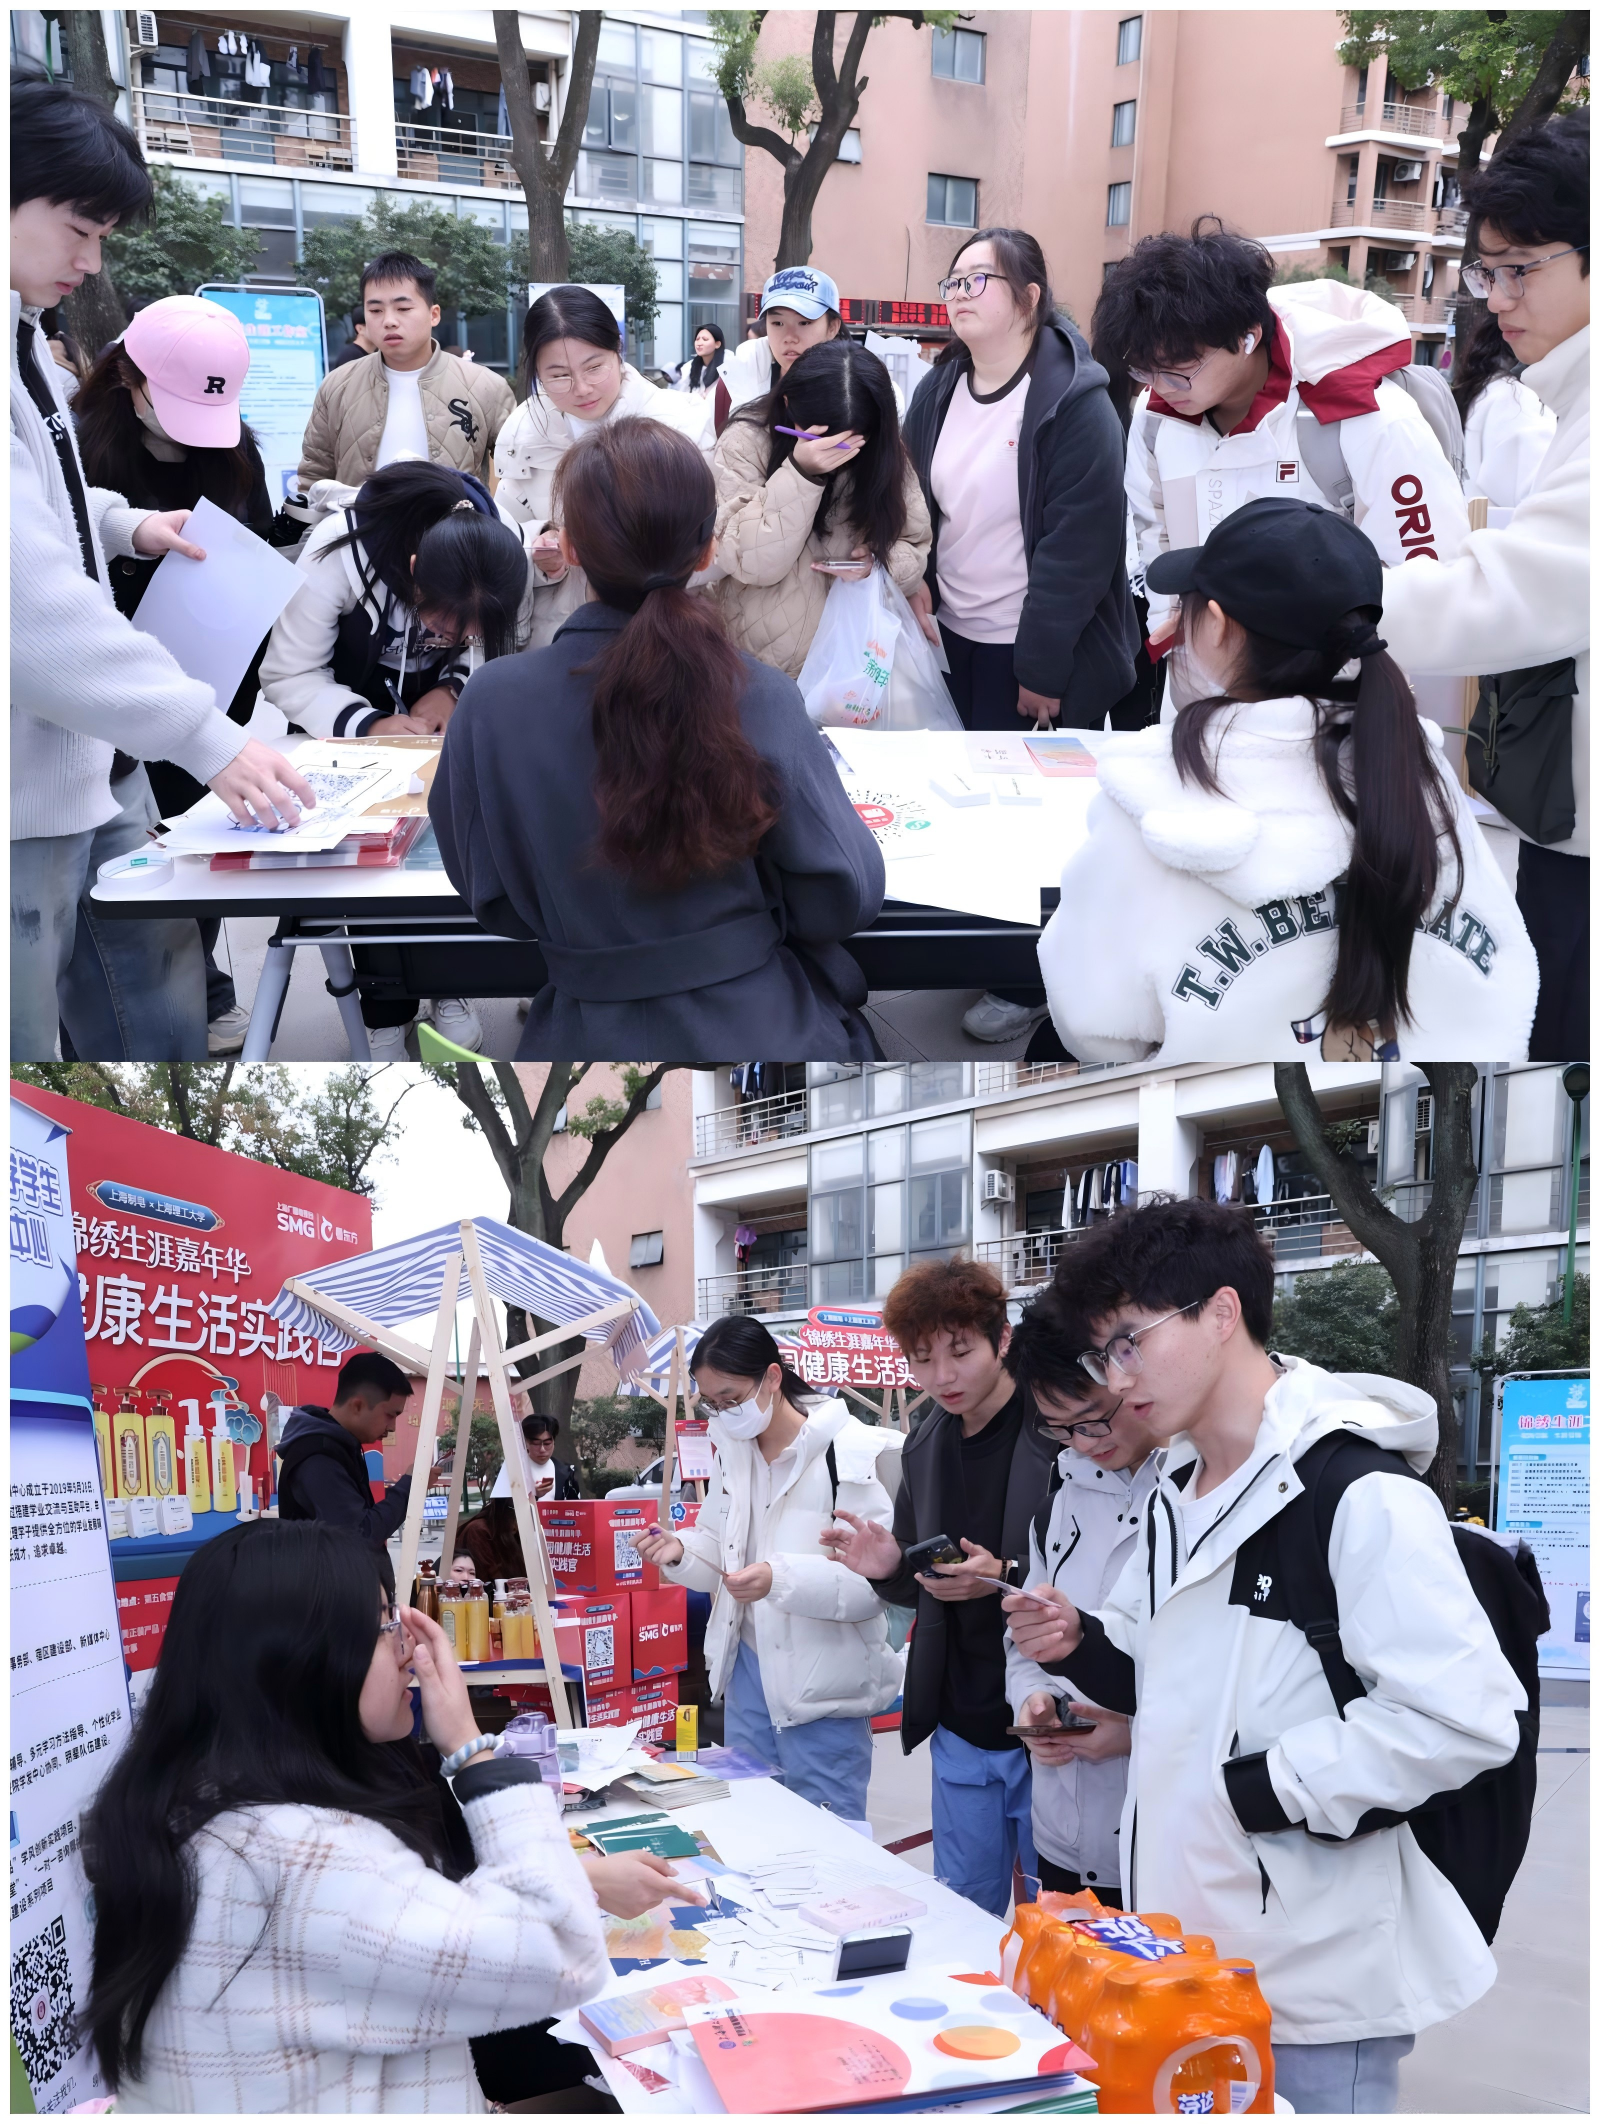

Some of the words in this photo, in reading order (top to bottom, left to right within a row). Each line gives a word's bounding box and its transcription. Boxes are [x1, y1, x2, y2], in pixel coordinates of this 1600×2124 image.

[204, 376, 226, 394] R
[277, 1213, 315, 1238] SMG
[77, 1272, 343, 1367] 康生活实践
[803, 1328, 900, 1353] 锦绣生涯嘉年华
[639, 1628, 659, 1642] SMG
[10, 1734, 110, 1796] 院学发中心协同、朋辈队伍建设。
